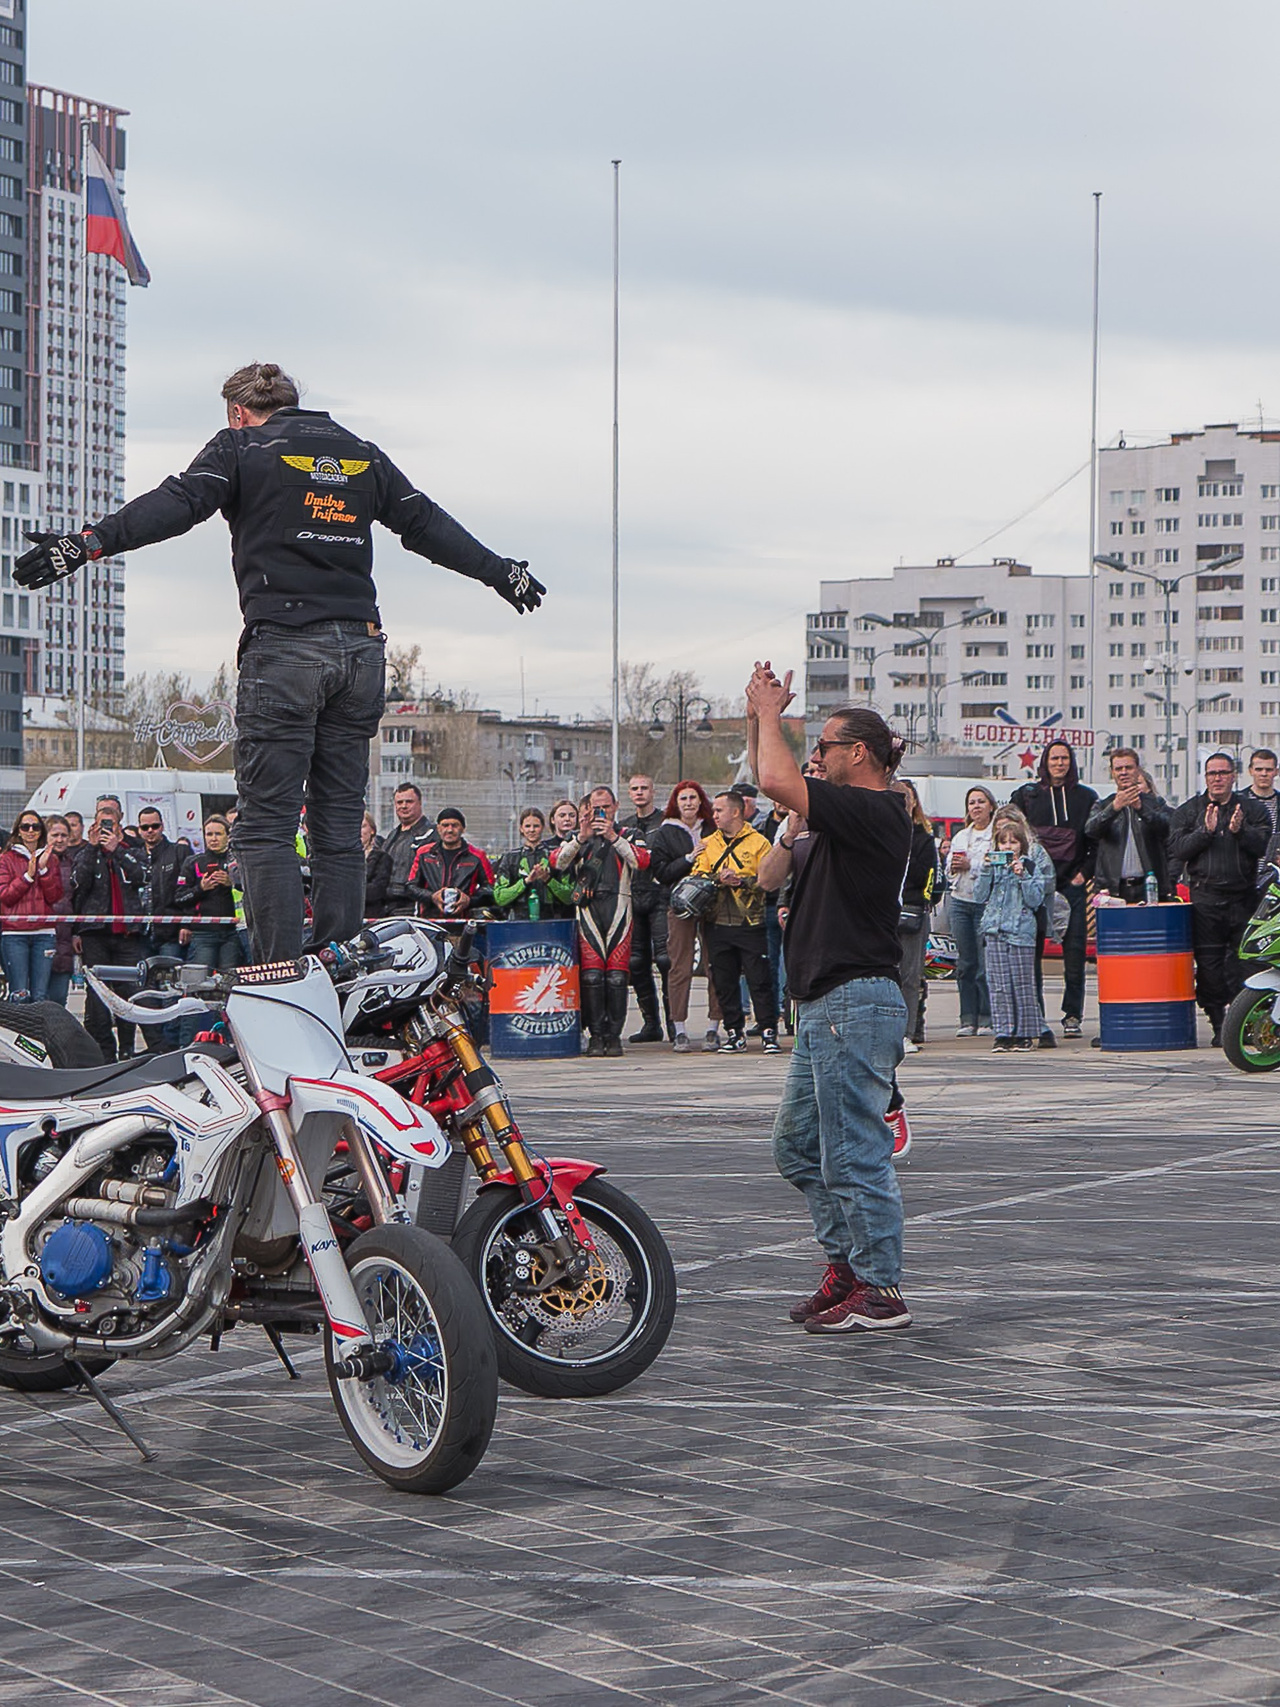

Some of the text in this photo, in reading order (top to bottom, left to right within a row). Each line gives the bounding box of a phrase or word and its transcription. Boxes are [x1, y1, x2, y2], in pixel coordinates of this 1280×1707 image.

[304, 492, 346, 511] Dmitry
[296, 531, 365, 545] Dragonfly
[964, 724, 1095, 747] #COFFEEHARD
[239, 967, 299, 983] RENTHAL
